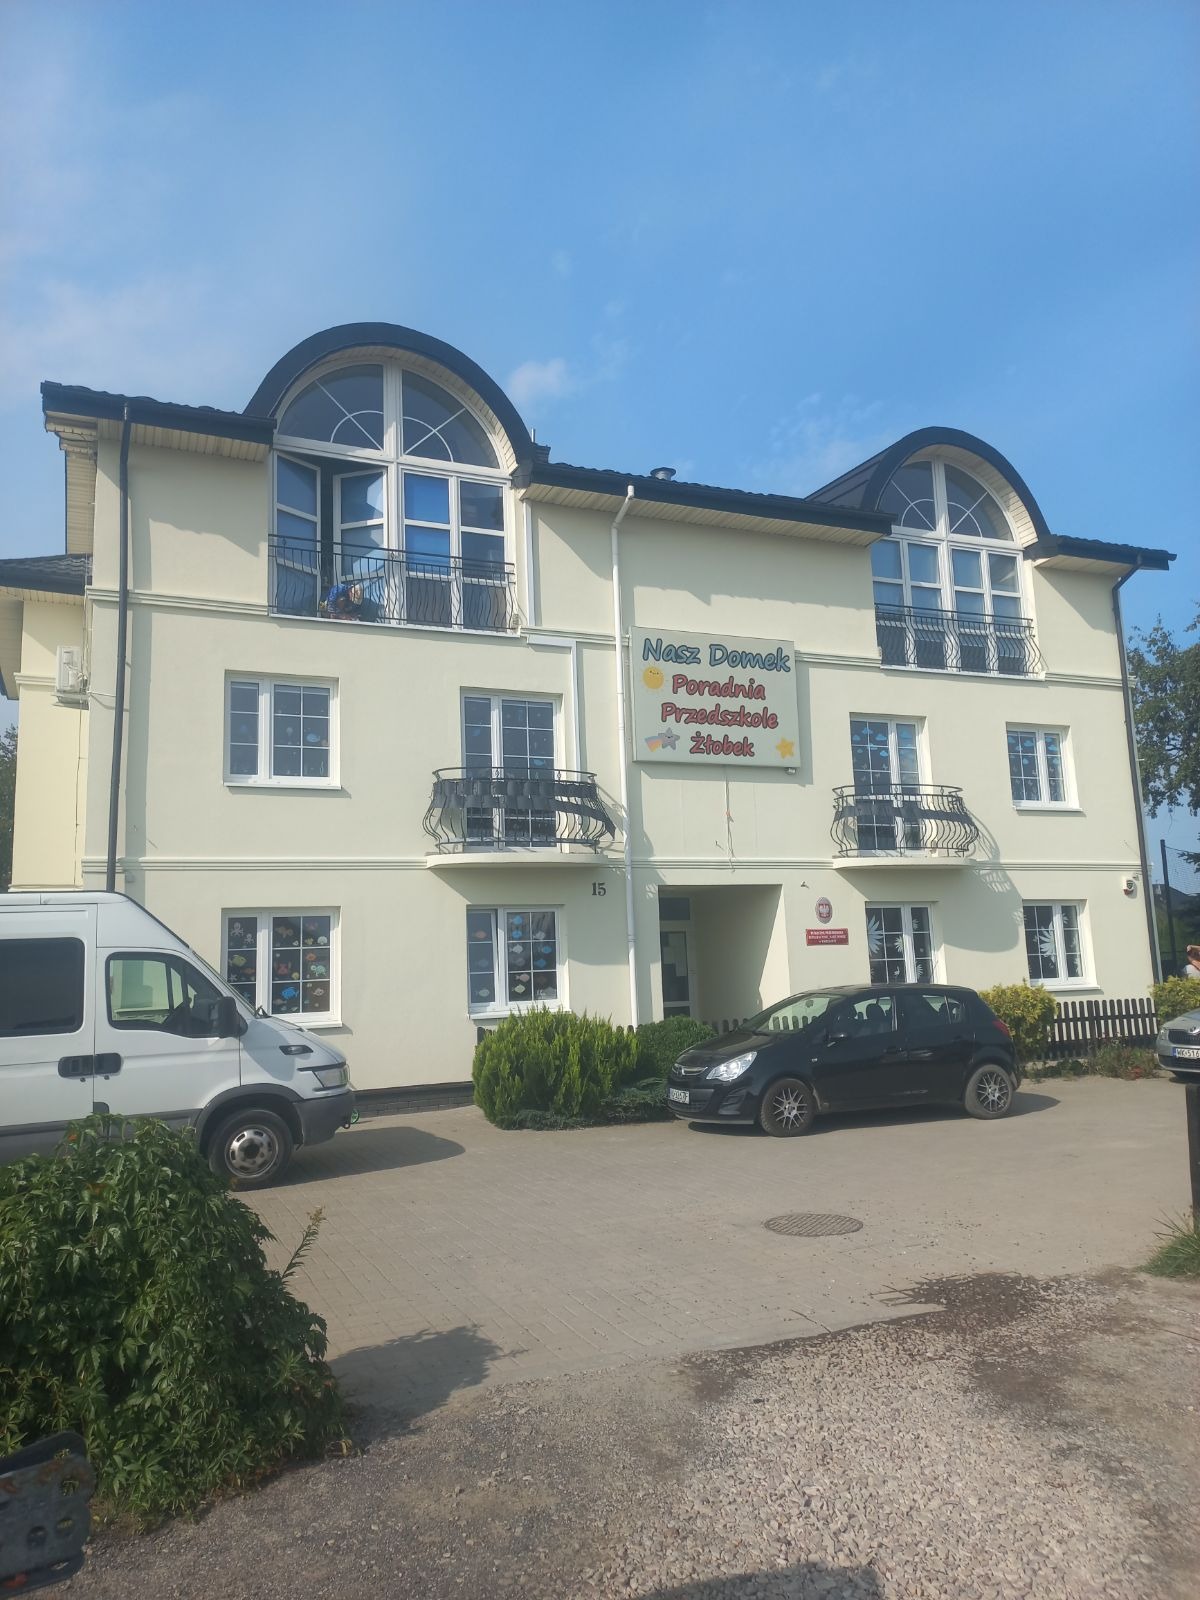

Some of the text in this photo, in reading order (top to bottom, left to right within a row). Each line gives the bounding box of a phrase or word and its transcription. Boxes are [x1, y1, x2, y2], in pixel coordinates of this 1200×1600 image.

[643, 638, 790, 672] Nasz Domek
[672, 674, 766, 700] Poradnia
[661, 702, 778, 729] Przedszkole
[689, 731, 755, 757] Żłobek
[591, 882, 606, 896] 15
